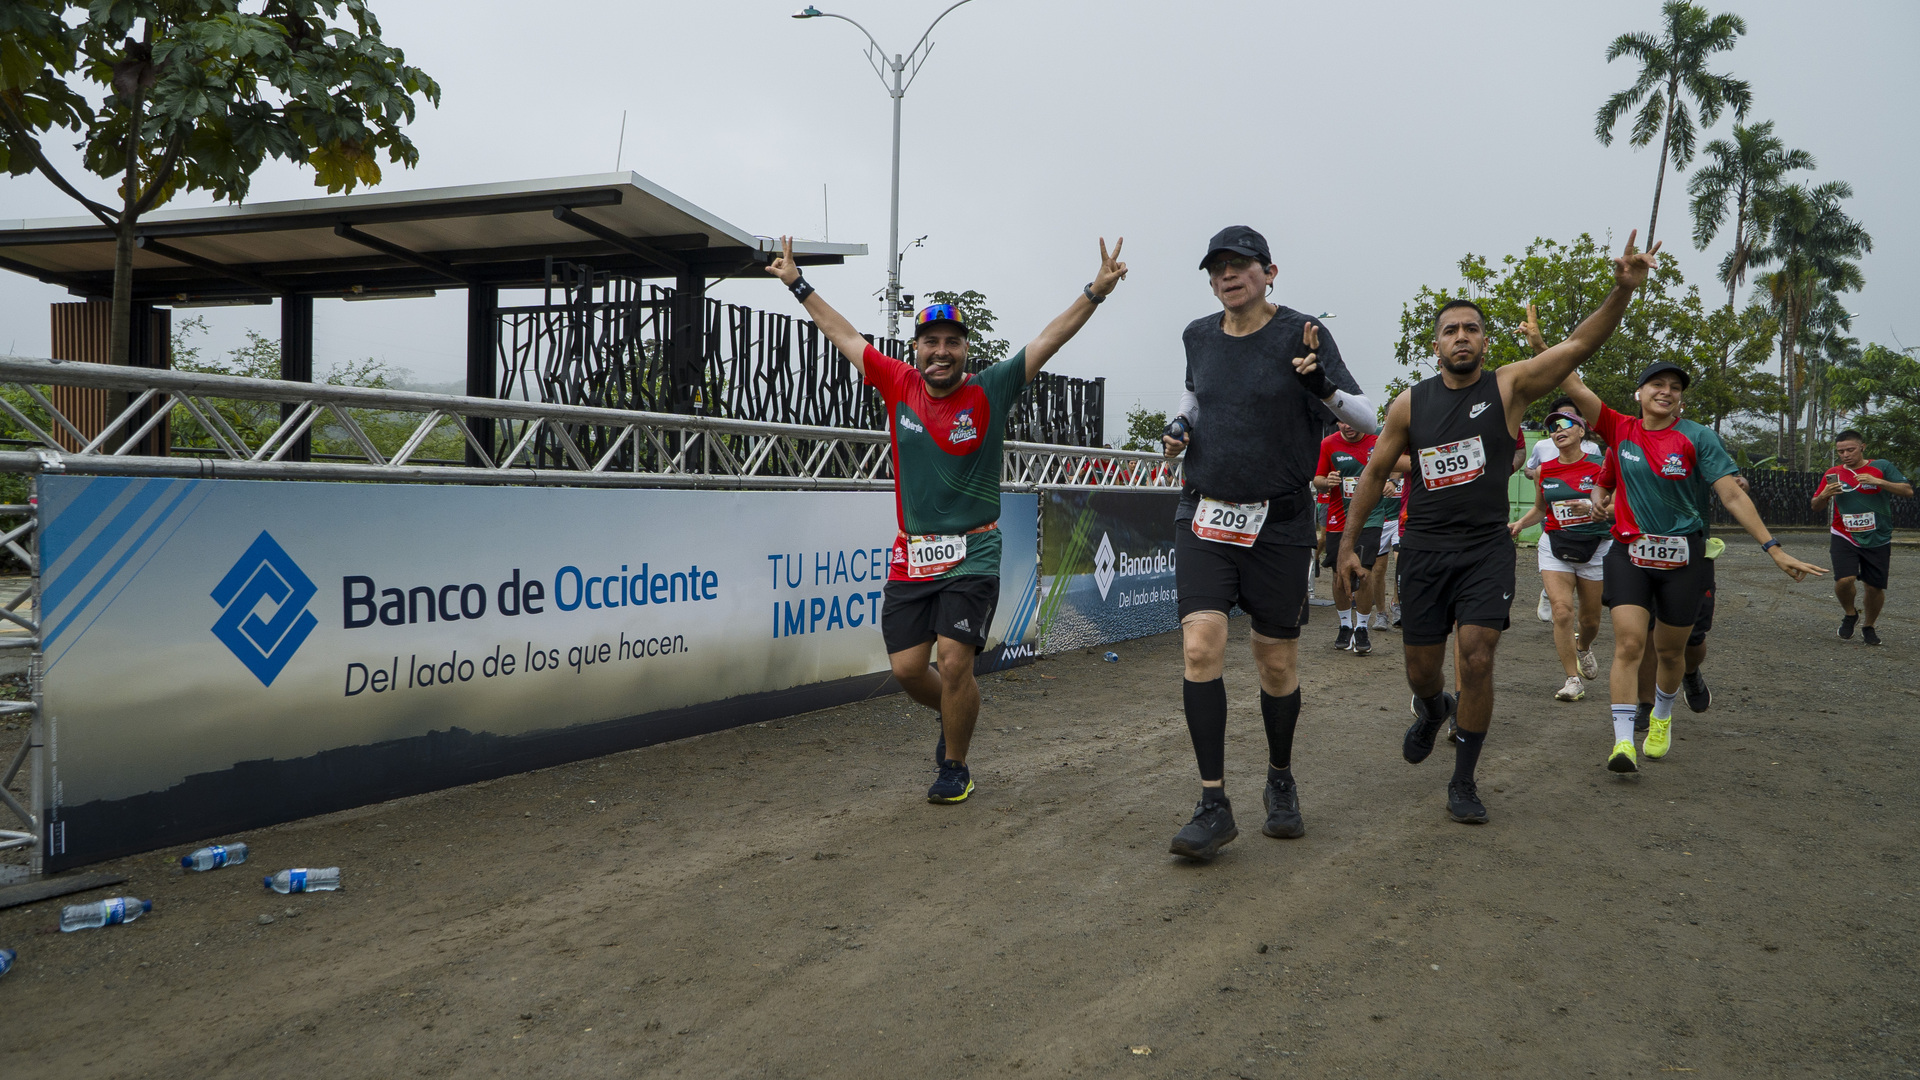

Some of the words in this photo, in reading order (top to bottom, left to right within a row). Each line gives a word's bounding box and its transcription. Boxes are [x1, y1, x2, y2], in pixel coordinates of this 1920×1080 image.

[1435, 454, 1469, 475] 959
[1210, 509, 1248, 530] 209
[1848, 518, 1869, 527] 1429
[916, 543, 955, 564] 1060
[1119, 551, 1152, 577] Banco
[1154, 549, 1167, 573] de
[1638, 544, 1678, 560] 1187
[767, 553, 803, 589] TU
[342, 574, 487, 629] Banco
[497, 568, 545, 616] de
[554, 563, 719, 612] Occidente
[1119, 590, 1132, 608] Del
[1132, 587, 1149, 606] lado
[1150, 586, 1159, 602] de
[1160, 585, 1170, 601] los
[773, 591, 882, 639] IMPACT
[1001, 643, 1034, 661] AVAL
[344, 657, 398, 697] Del
[409, 650, 475, 688] lado
[482, 645, 517, 678] de
[524, 641, 560, 673] los
[569, 640, 612, 674] que
[618, 632, 689, 661] hacen.
